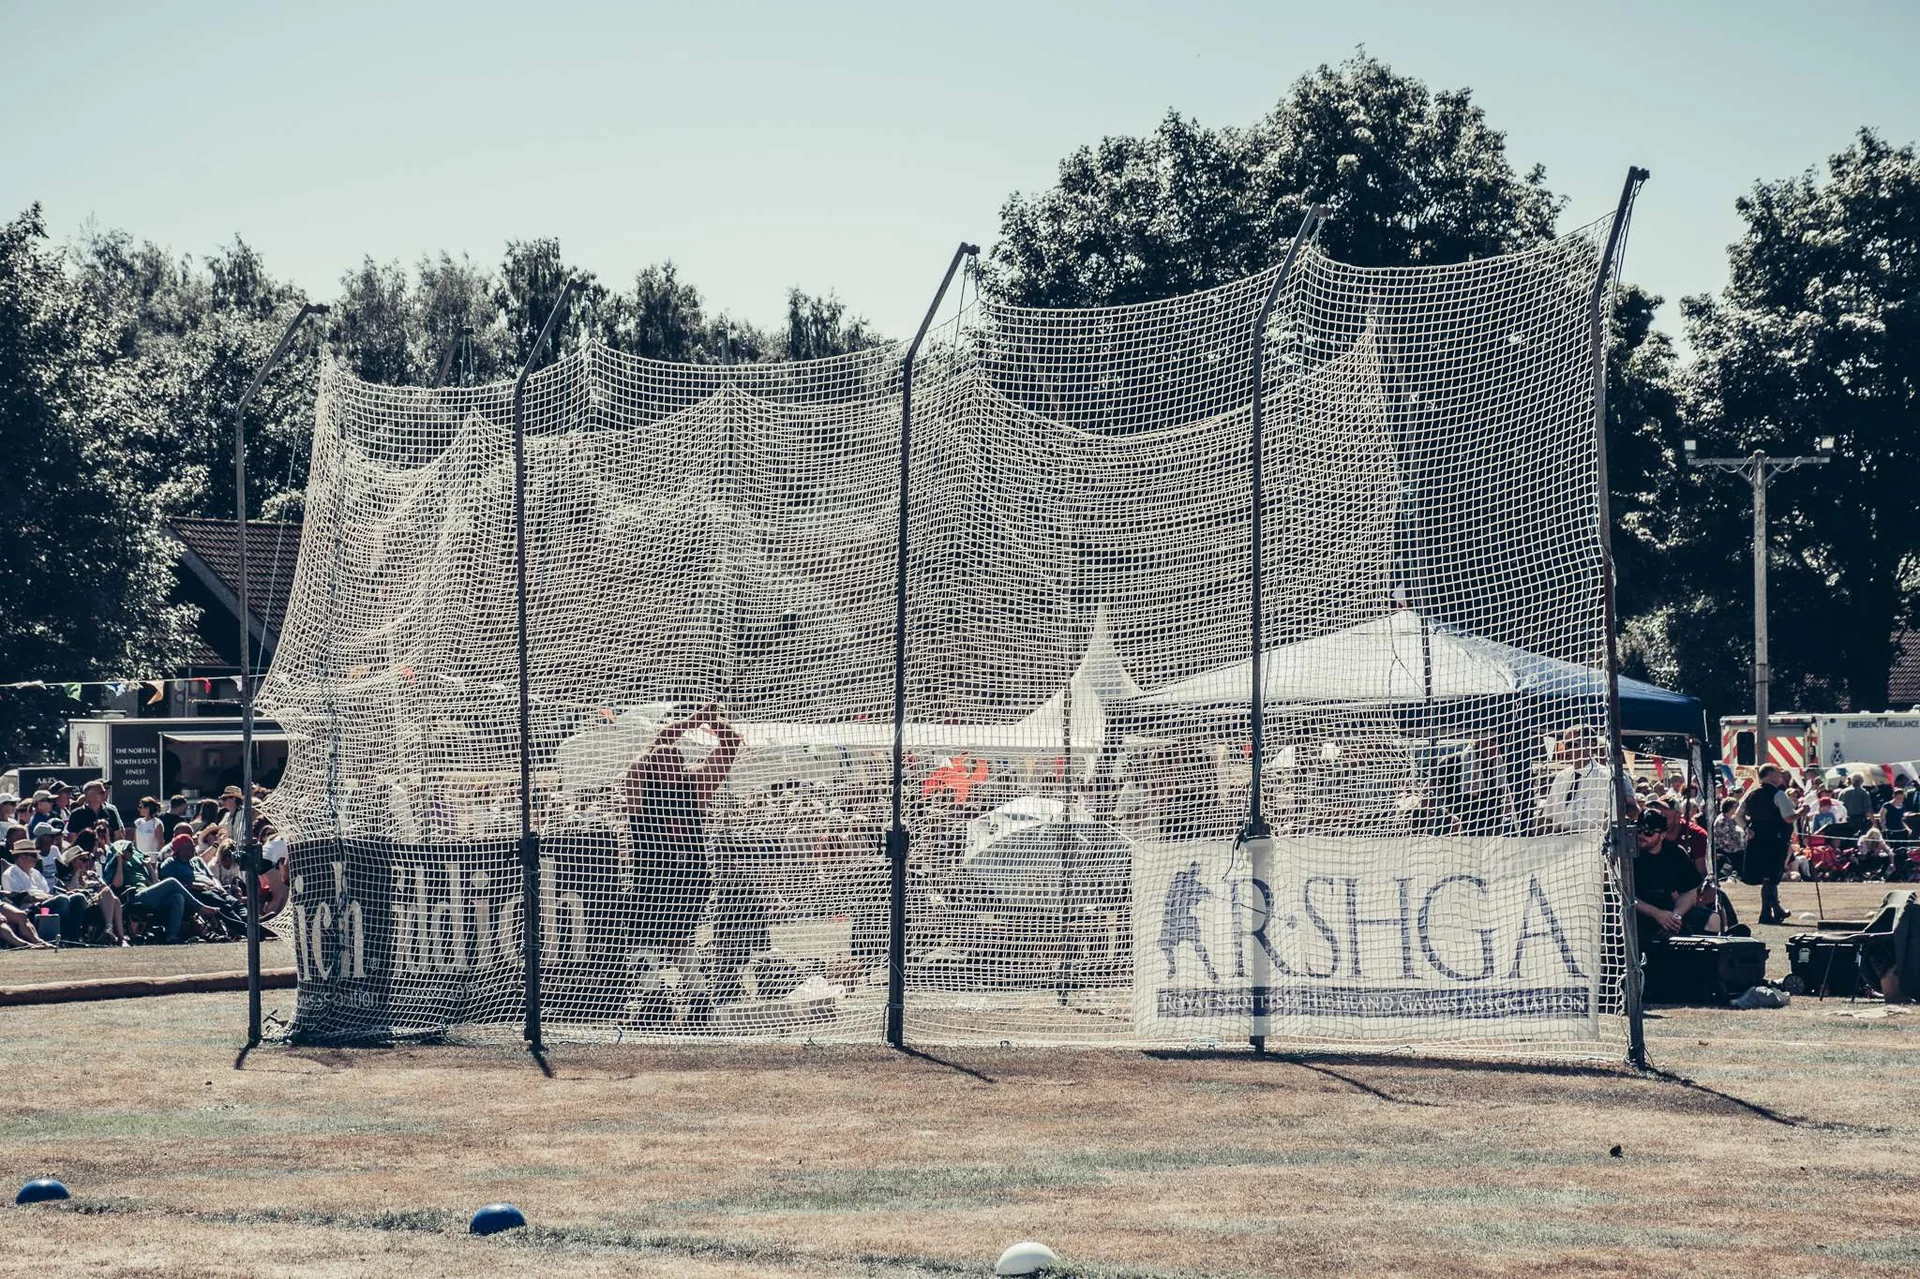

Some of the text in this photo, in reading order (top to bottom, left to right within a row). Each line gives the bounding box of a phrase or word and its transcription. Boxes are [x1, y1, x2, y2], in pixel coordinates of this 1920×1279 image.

[1847, 720, 1920, 728] EMERGENCY AMBULANCE
[1227, 874, 1589, 982] RSHGA
[1162, 993, 1586, 1011] ROYAL SCOTTISH HIGHLAND GAMES ASSOCIATION
